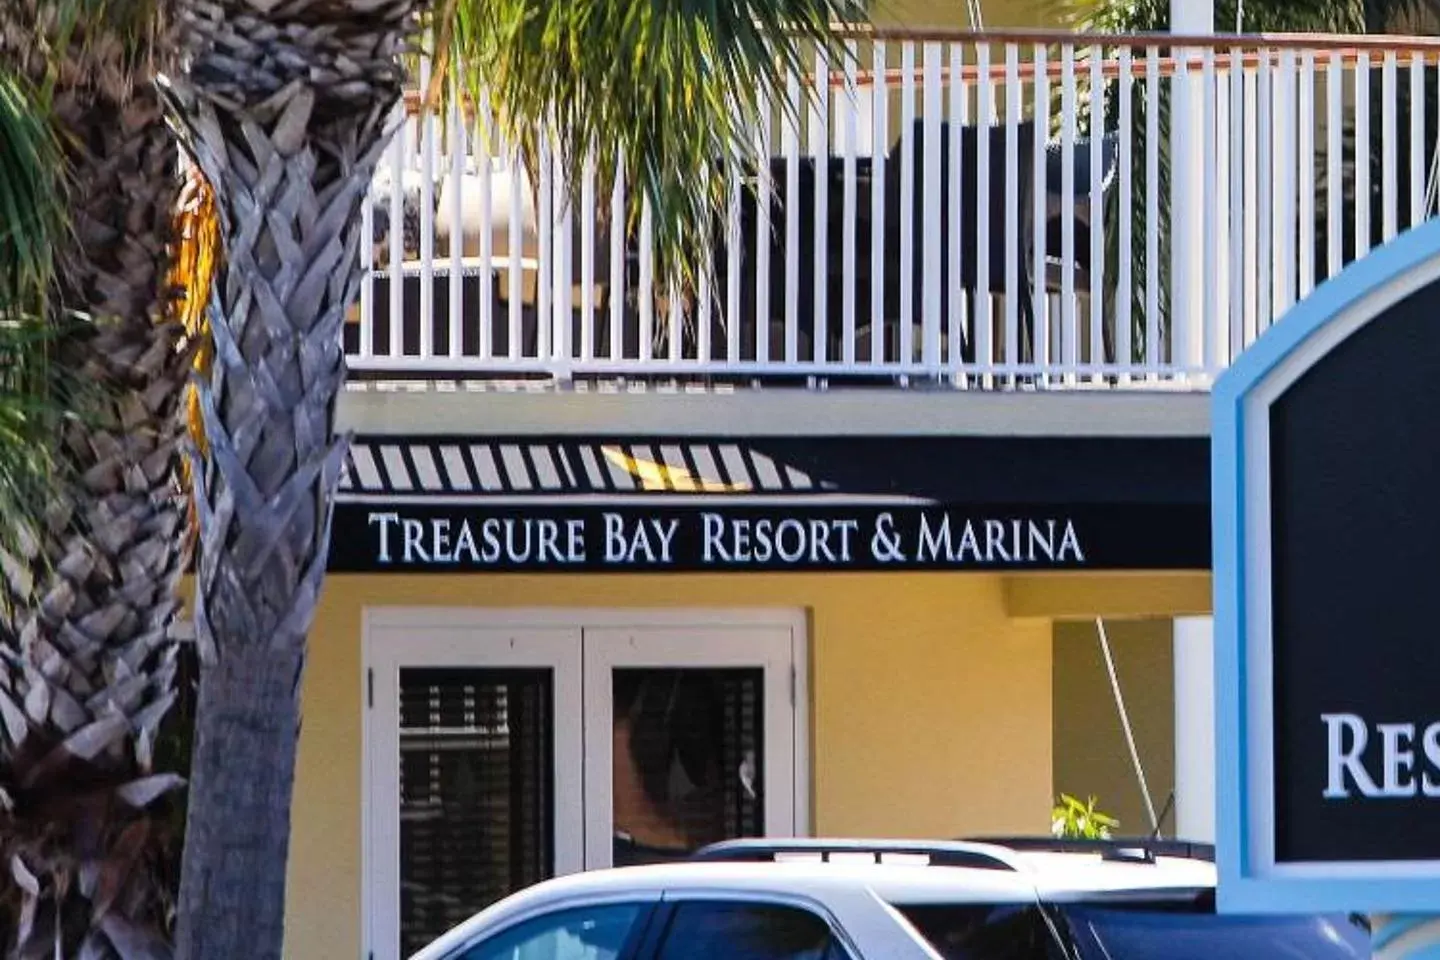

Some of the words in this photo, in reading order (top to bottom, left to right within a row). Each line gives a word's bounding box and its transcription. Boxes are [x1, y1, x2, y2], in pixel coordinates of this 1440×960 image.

[366, 512, 587, 563] TREASURE
[604, 512, 679, 563] BAY
[702, 513, 856, 563] RESORT
[870, 512, 906, 563] &
[916, 511, 1084, 563] MARINA
